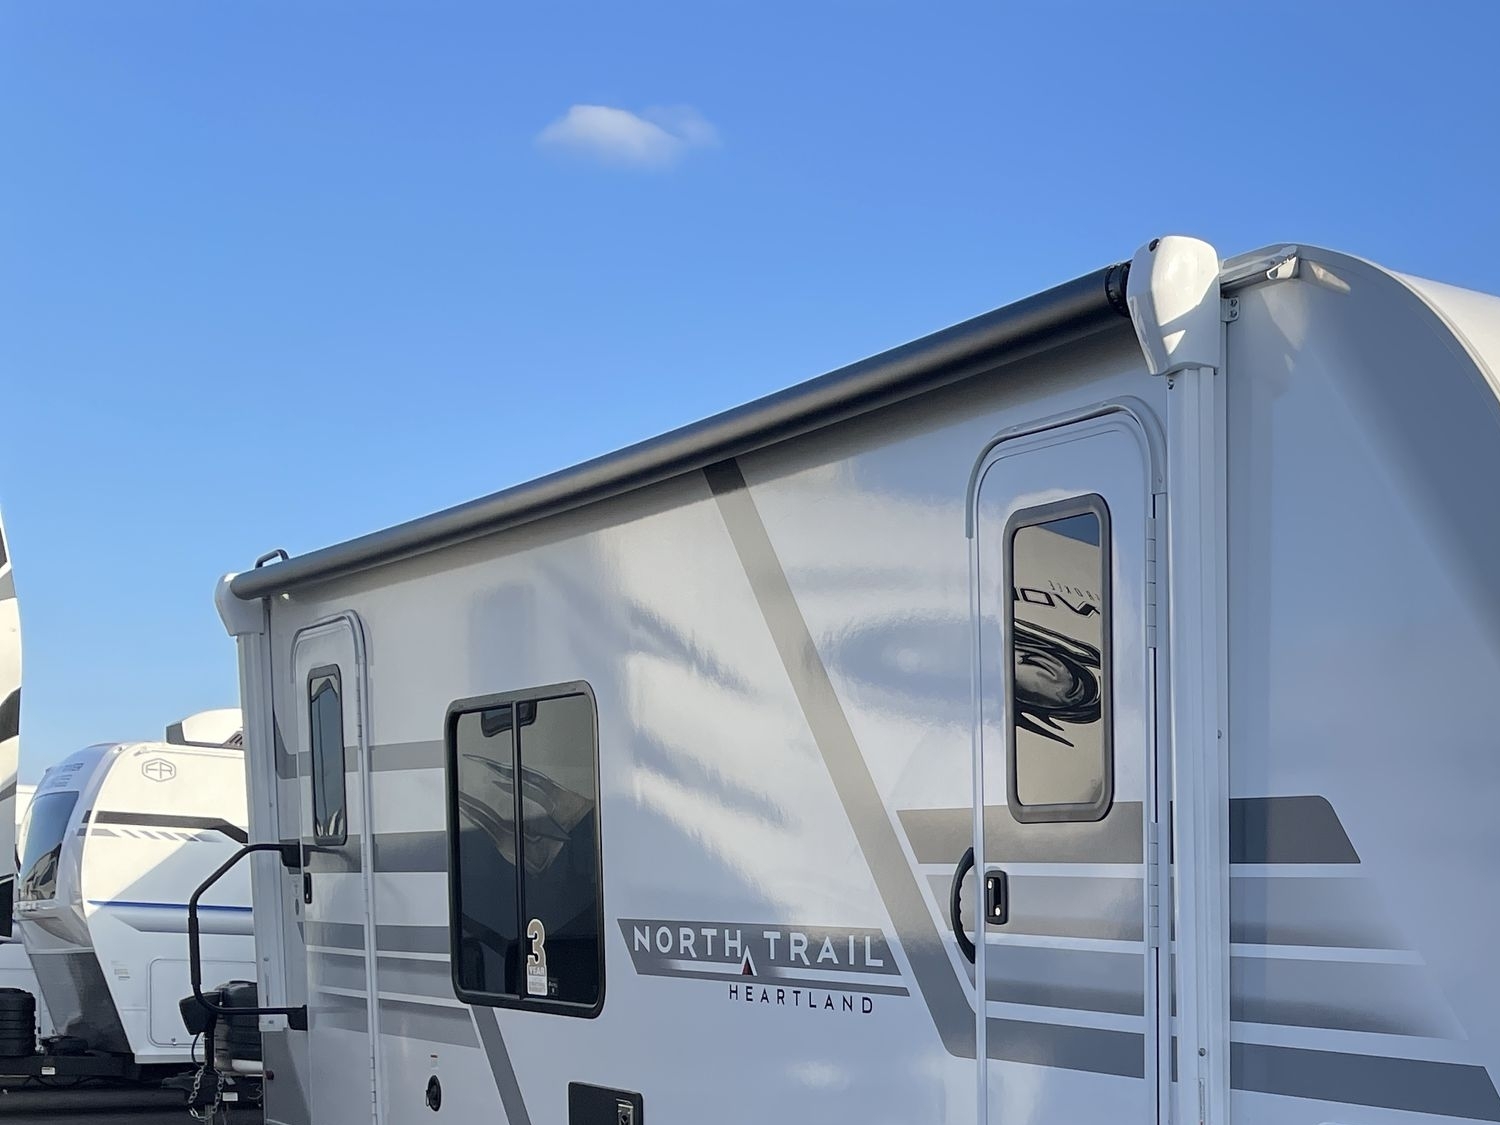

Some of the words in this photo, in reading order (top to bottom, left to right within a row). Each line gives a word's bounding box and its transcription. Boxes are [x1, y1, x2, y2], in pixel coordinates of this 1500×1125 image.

[633, 925, 741, 958] NORTH
[763, 931, 884, 967] TRAIL
[729, 984, 873, 1014] HEARTLAND
